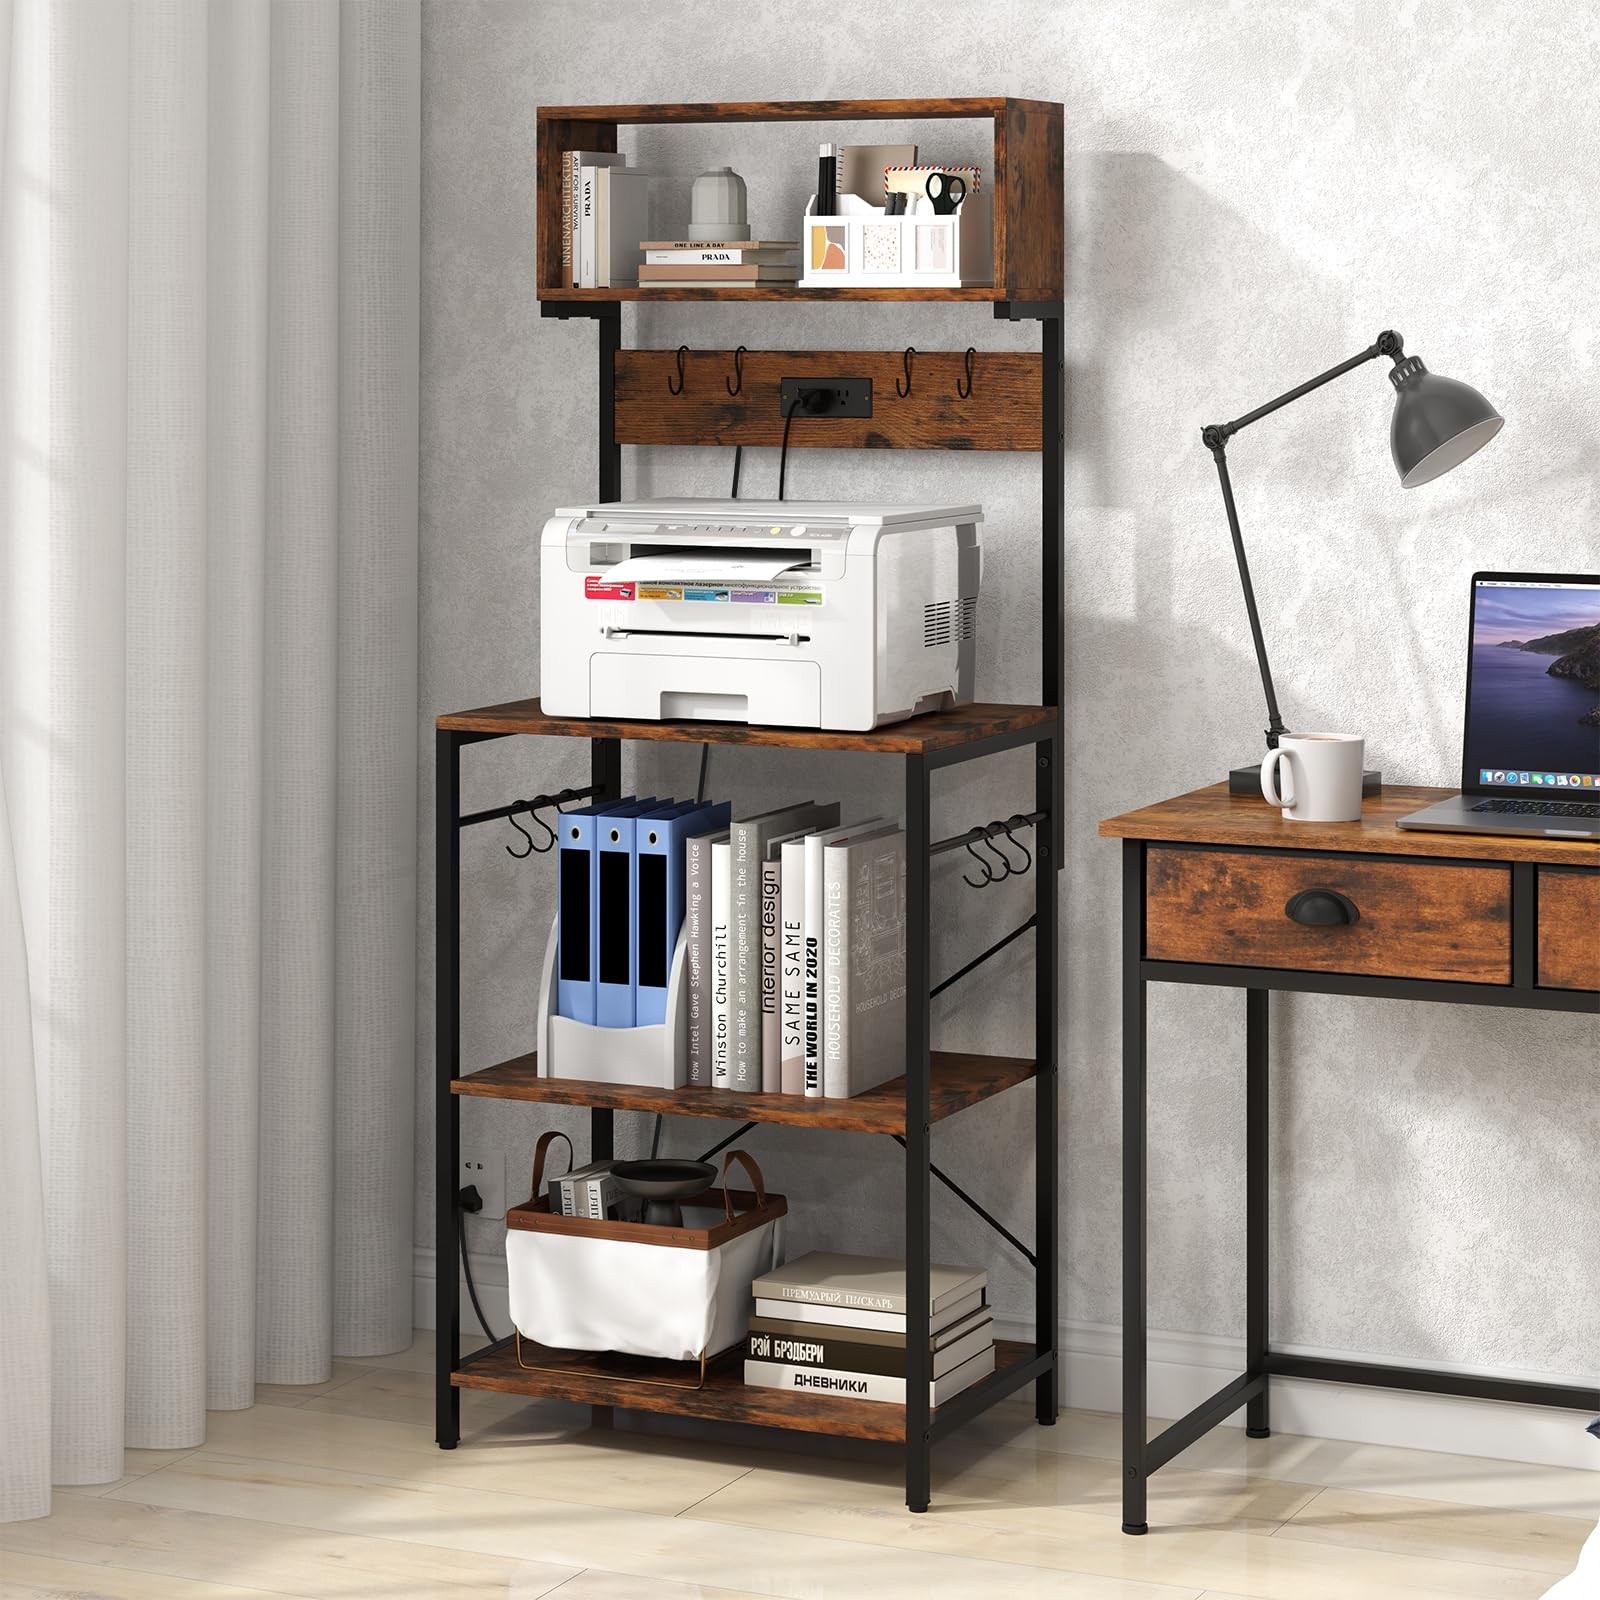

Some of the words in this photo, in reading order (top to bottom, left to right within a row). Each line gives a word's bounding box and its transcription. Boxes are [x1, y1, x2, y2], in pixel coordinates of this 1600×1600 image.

[562, 151, 571, 267] INNENARCHITEKTUR
[701, 253, 730, 261] PRADA
[690, 844, 700, 875] Voice
[736, 829, 747, 861] house
[736, 868, 746, 887] the
[736, 894, 746, 906] in
[762, 870, 780, 937] design
[690, 894, 702, 938] Hawking
[828, 882, 840, 966] DECORATES
[737, 913, 749, 984] arrangement
[785, 921, 800, 976] SAME
[806, 937, 817, 978] 2020
[691, 944, 701, 987] Stephen
[715, 925, 727, 1004] Churchill
[762, 943, 775, 1014] Interior
[738, 990, 746, 1003] an
[806, 982, 817, 998] IN
[856, 993, 888, 1015] HOUSEHOLD
[691, 993, 699, 1018] Gave
[785, 990, 800, 1045] SAME
[828, 976, 840, 1060] HOUSEHOLD
[737, 1009, 746, 1036] make
[806, 1002, 817, 1058] WORLD
[690, 1025, 699, 1055] Intel
[715, 1014, 727, 1077] Winston
[737, 1042, 746, 1054] to
[691, 1061, 699, 1081] How
[737, 1061, 746, 1081] How
[806, 1062, 817, 1089] THE
[782, 1287, 841, 1303] ПРЕМУДРЫЙ
[845, 1294, 893, 1309] ПИСКАРЬ
[751, 1334, 770, 1357] РЭЙ
[774, 1340, 824, 1363] БРЭДБЕРИ
[794, 1373, 867, 1393] ДНЕВНИКИ
